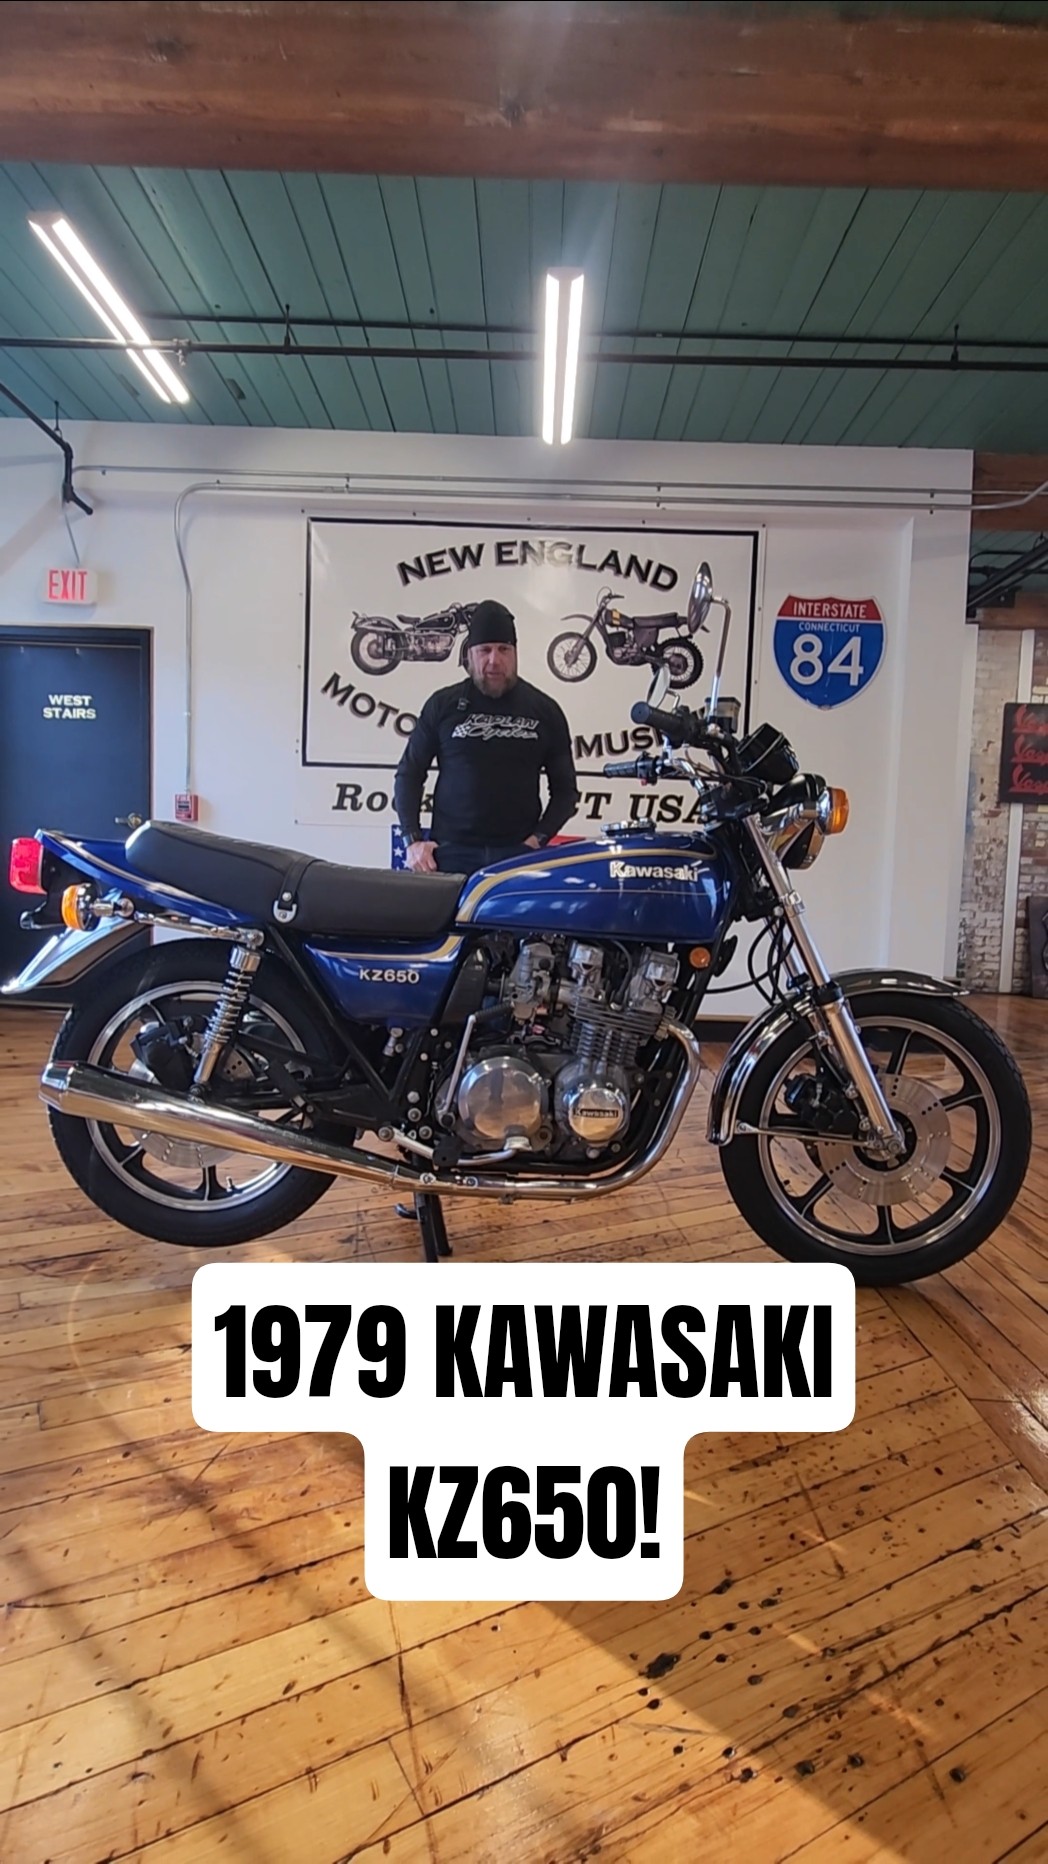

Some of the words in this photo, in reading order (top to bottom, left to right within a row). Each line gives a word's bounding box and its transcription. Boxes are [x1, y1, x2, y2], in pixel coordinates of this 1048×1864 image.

[397, 543, 484, 586] NEW
[495, 540, 678, 592] ENGLAND
[48, 569, 88, 601] EXIT
[793, 601, 867, 618] INTERSTATE
[798, 622, 860, 633] CONNECTICUT
[790, 633, 864, 686] 84
[48, 694, 92, 706] WEST
[43, 707, 96, 719] STAIRS
[321, 671, 419, 737] MOTO
[574, 726, 664, 760] MUS
[609, 860, 699, 882] Kawasaki
[359, 968, 420, 985] KZ650
